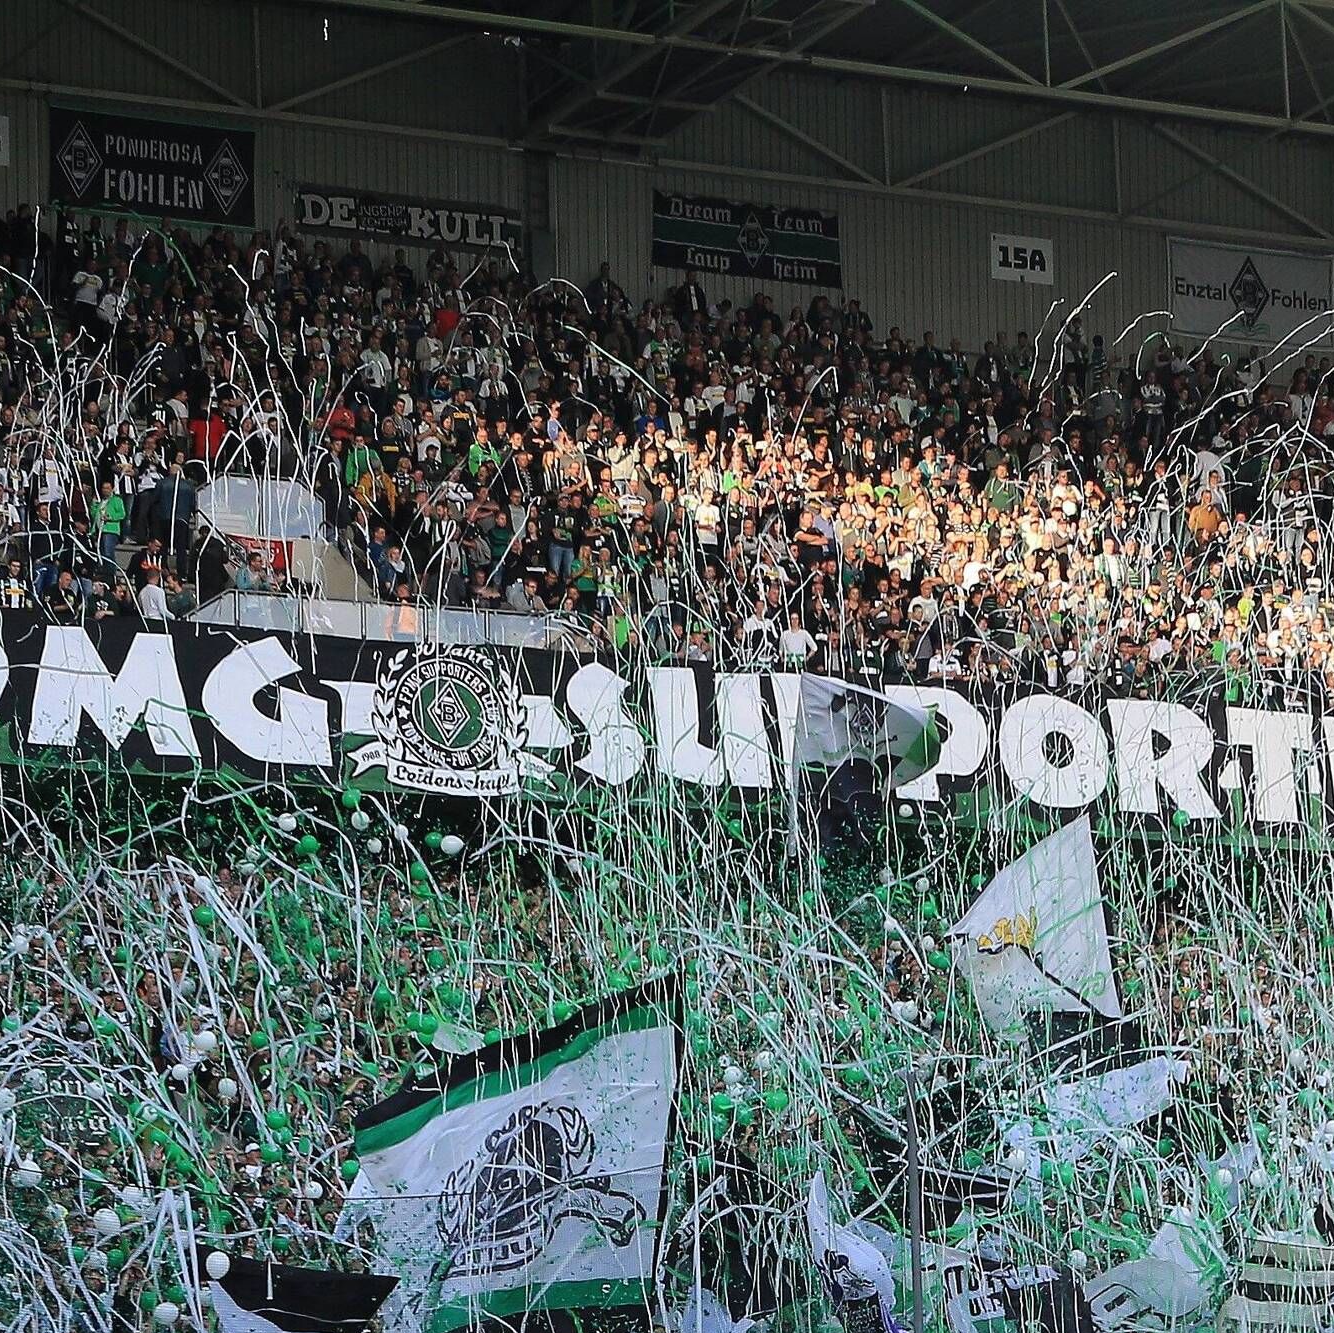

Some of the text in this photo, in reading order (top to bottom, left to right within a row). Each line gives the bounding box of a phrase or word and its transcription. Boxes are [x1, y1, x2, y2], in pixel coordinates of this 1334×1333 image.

[104, 133, 204, 166] PONDEROSA
[301, 193, 357, 230] DE
[668, 197, 824, 234] Dream Team
[772, 256, 819, 281] heim
[998, 245, 1047, 272] 15A
[1174, 277, 1328, 311] Enztal Fohlen
[420, 661, 487, 695] SUPPORTERS
